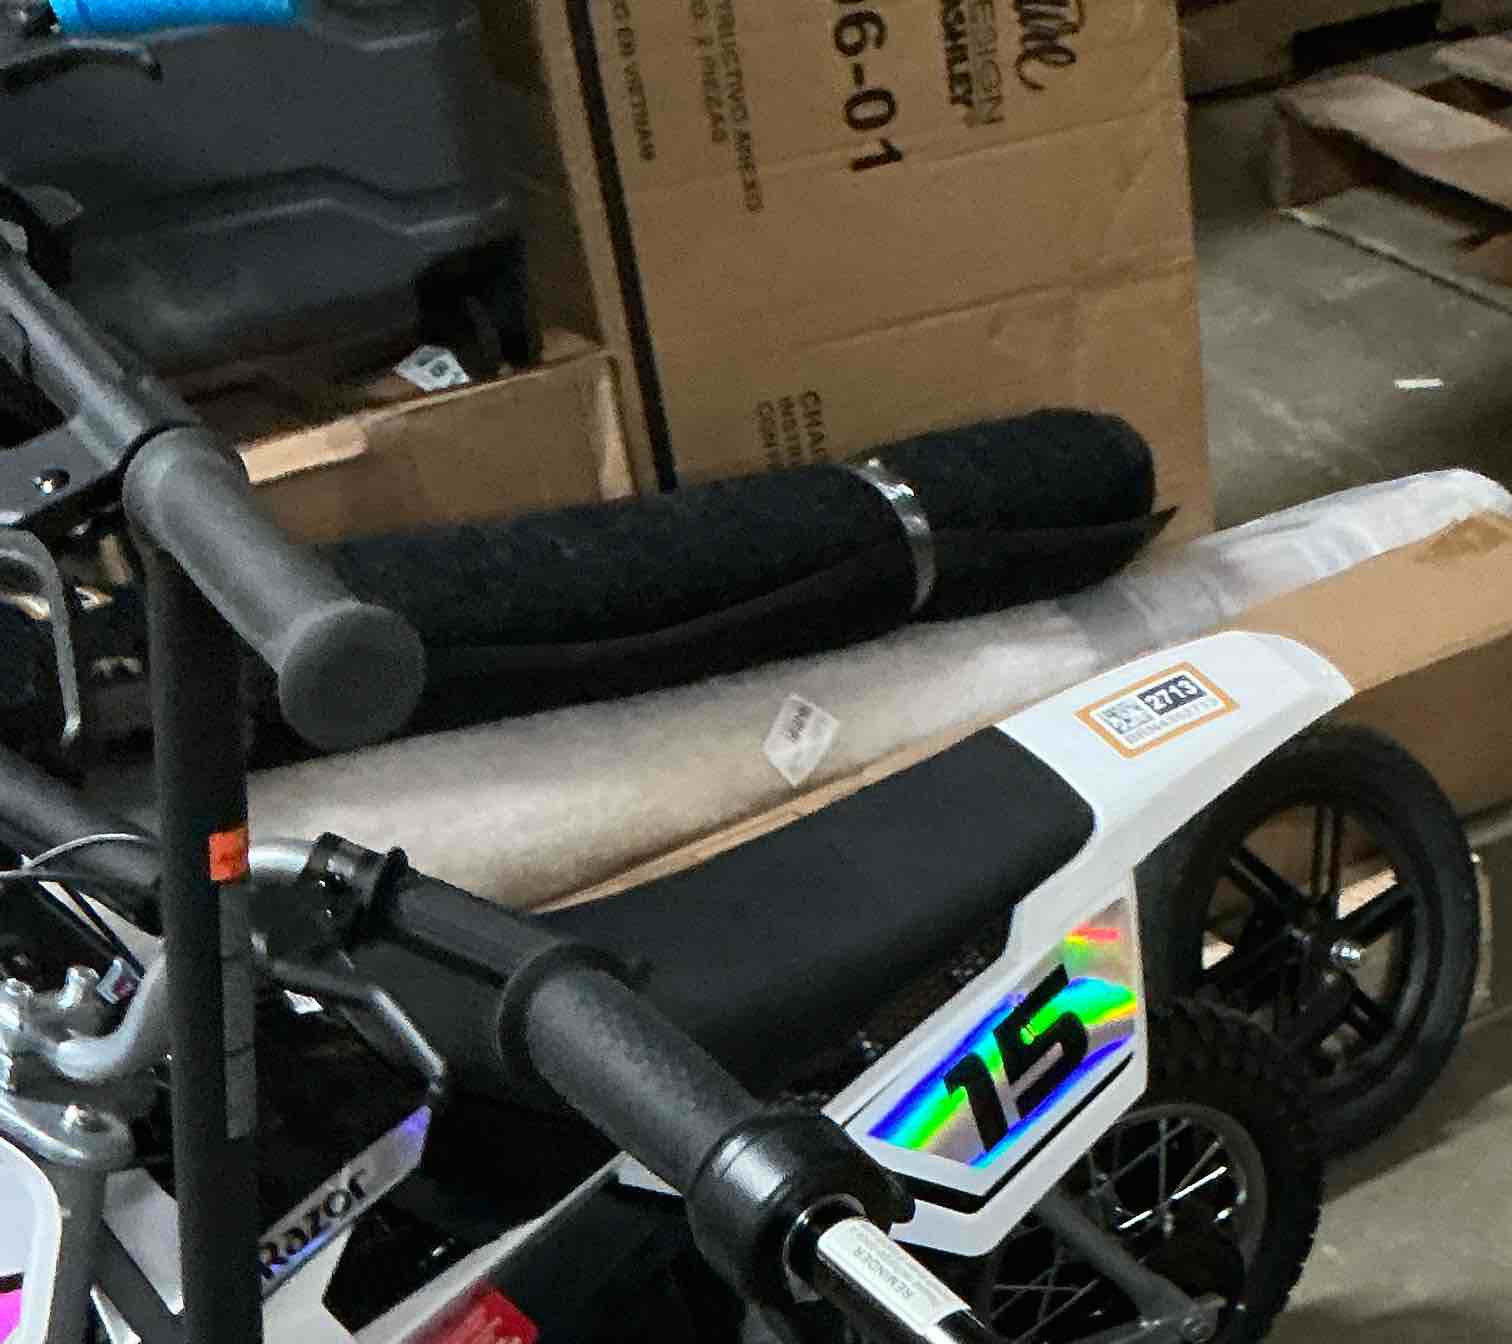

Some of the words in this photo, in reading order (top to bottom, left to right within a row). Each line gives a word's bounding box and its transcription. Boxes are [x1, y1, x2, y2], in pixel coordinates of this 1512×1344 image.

[834, 0, 902, 170] 6-01
[1144, 680, 1198, 710] 2713
[944, 963, 1087, 1153] 15
[257, 1168, 367, 1279] Razor
[853, 1245, 914, 1298] REMINDER
